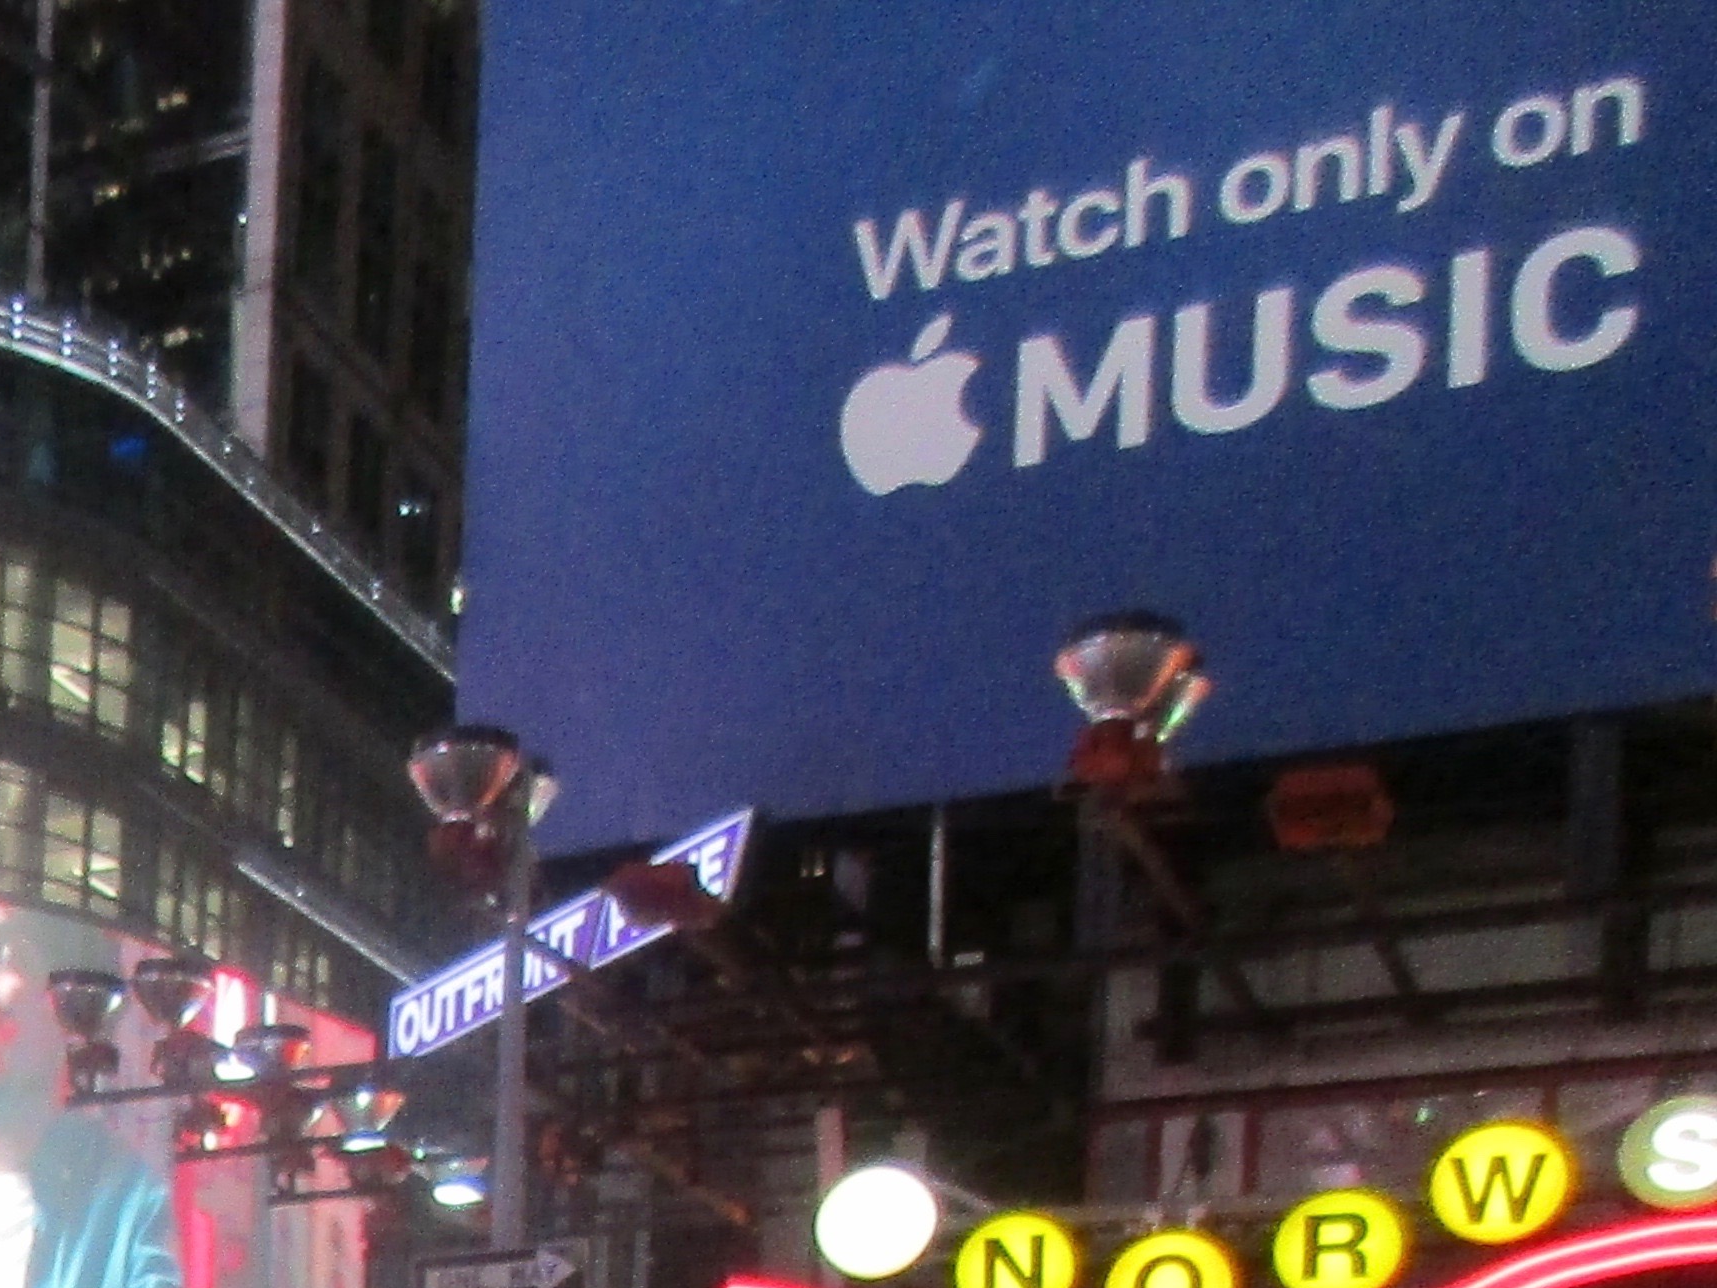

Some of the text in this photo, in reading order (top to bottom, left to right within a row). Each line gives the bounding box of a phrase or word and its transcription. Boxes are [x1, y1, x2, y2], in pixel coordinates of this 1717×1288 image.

[853, 75, 1645, 301] Watch only on
[1012, 227, 1642, 469] MUSIC
[1303, 1211, 1370, 1280] R
[1450, 1152, 1549, 1226] W
